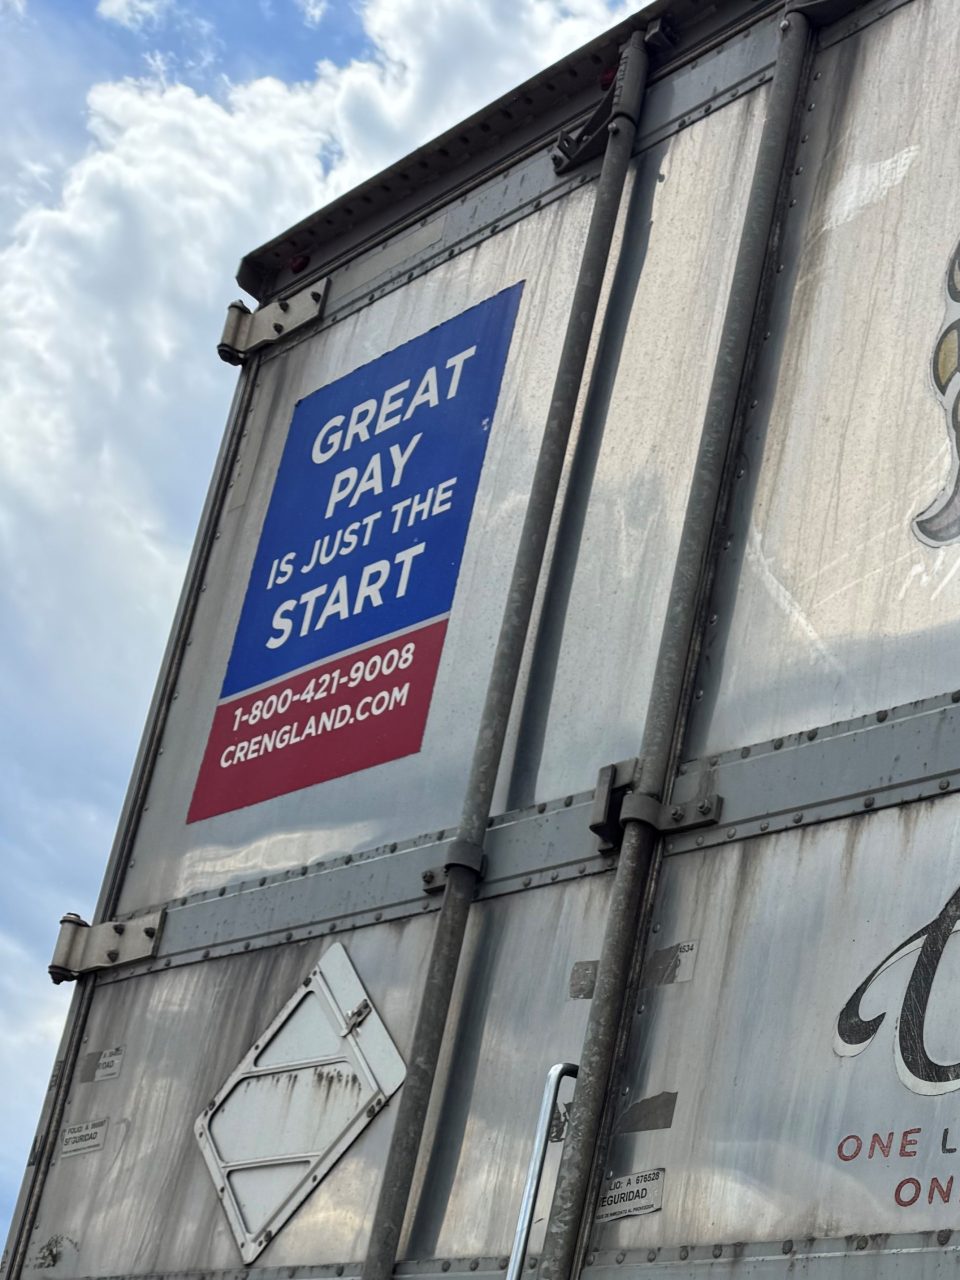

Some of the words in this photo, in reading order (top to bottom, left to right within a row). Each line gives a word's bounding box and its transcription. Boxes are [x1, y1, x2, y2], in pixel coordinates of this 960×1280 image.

[311, 345, 477, 465] GREAT
[325, 432, 423, 520] PAY
[266, 552, 297, 590] IS
[300, 511, 382, 574] JUST
[391, 477, 457, 534] THE
[265, 542, 426, 649] START
[220, 682, 410, 769] CRENGLAND.COM
[233, 642, 415, 732] 1-800-421-9008
[609, 1180, 623, 1190] LIO:
[626, 1177, 631, 1187] A
[837, 1127, 921, 1162] ONE
[600, 1187, 648, 1207] EGURIDAD
